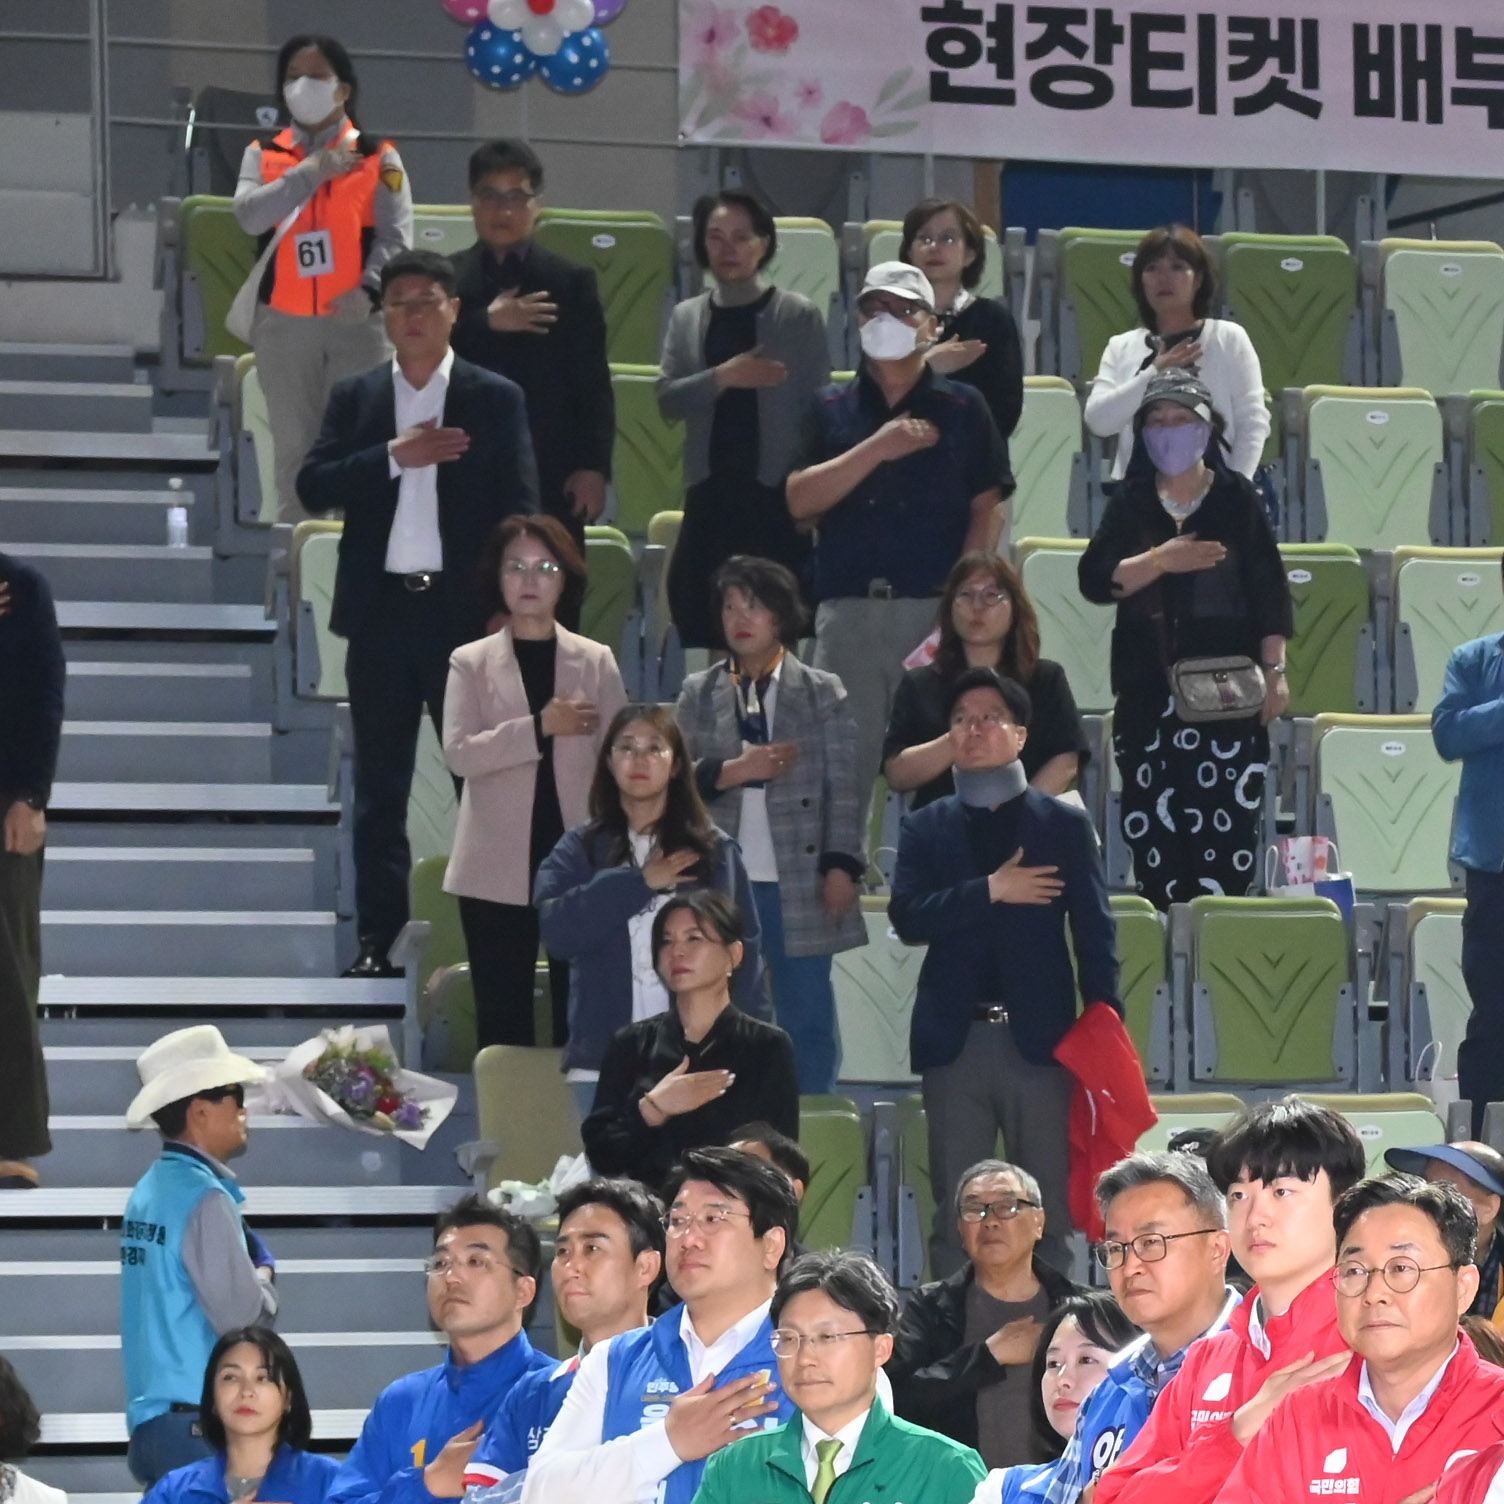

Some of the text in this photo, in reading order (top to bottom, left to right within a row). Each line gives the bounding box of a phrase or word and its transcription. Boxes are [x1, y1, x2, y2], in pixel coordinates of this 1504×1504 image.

[921, 0, 1323, 120] 현장티켓
[298, 239, 326, 268] 61
[410, 1439, 426, 1467] 1
[1309, 1478, 1360, 1495] 국민의힘
